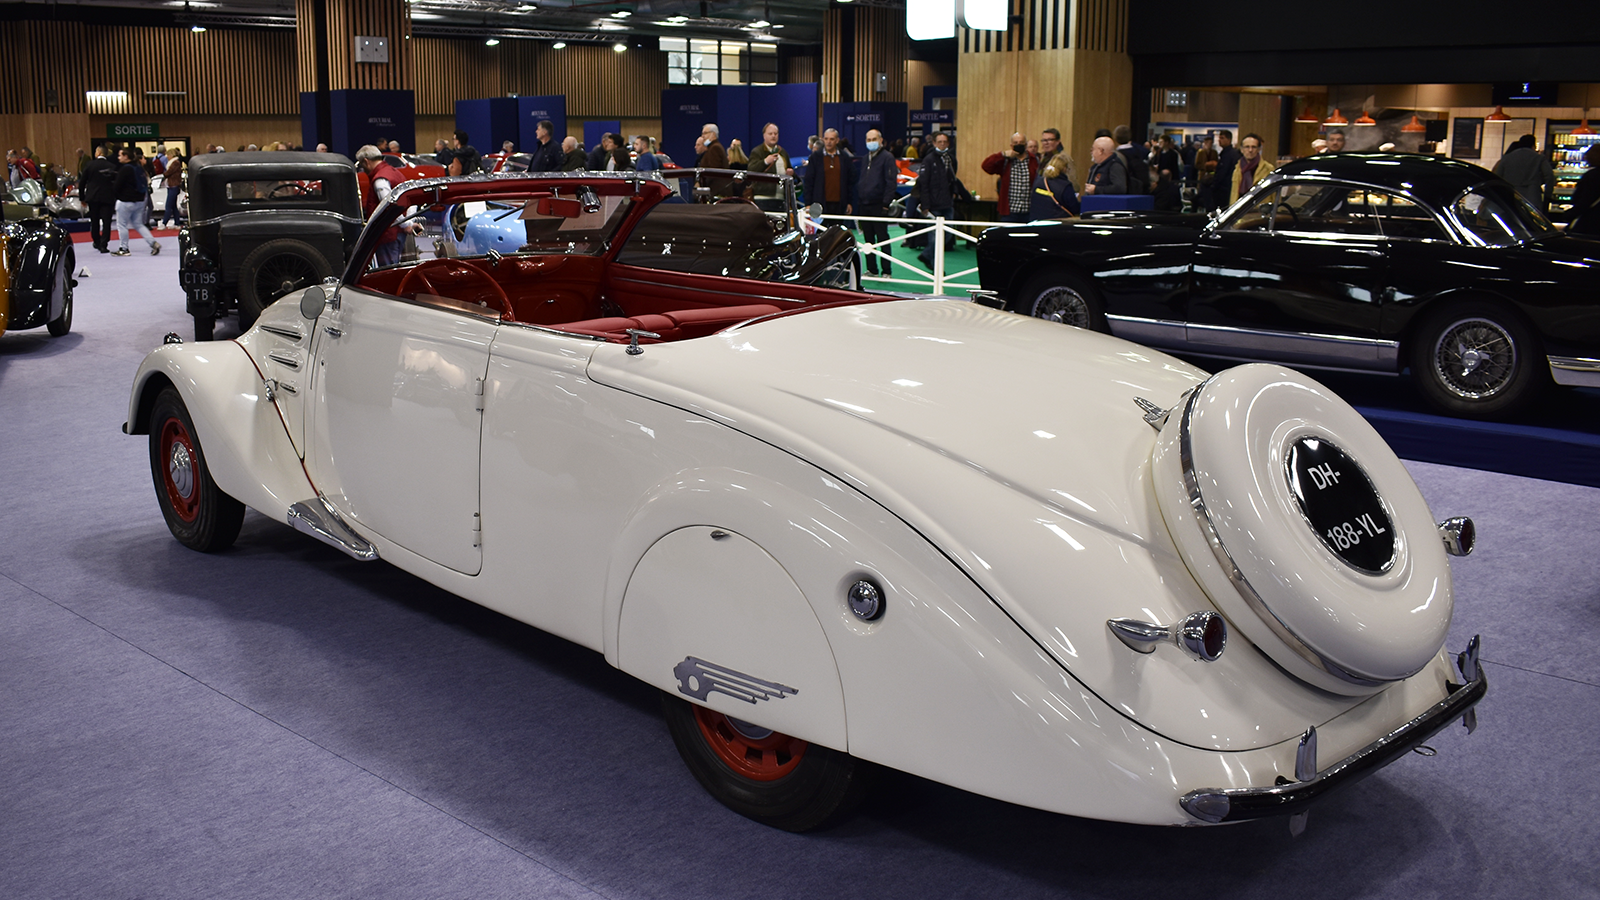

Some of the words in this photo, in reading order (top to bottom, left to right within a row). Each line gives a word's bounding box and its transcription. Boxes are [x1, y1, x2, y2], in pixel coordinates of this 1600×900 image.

[855, 114, 880, 122] SORTIE
[913, 113, 939, 121] SORTIE
[115, 125, 152, 135] SORTIE
[193, 289, 209, 300] TB
[1307, 462, 1341, 490] DH-
[1327, 513, 1386, 551] 188-YL
